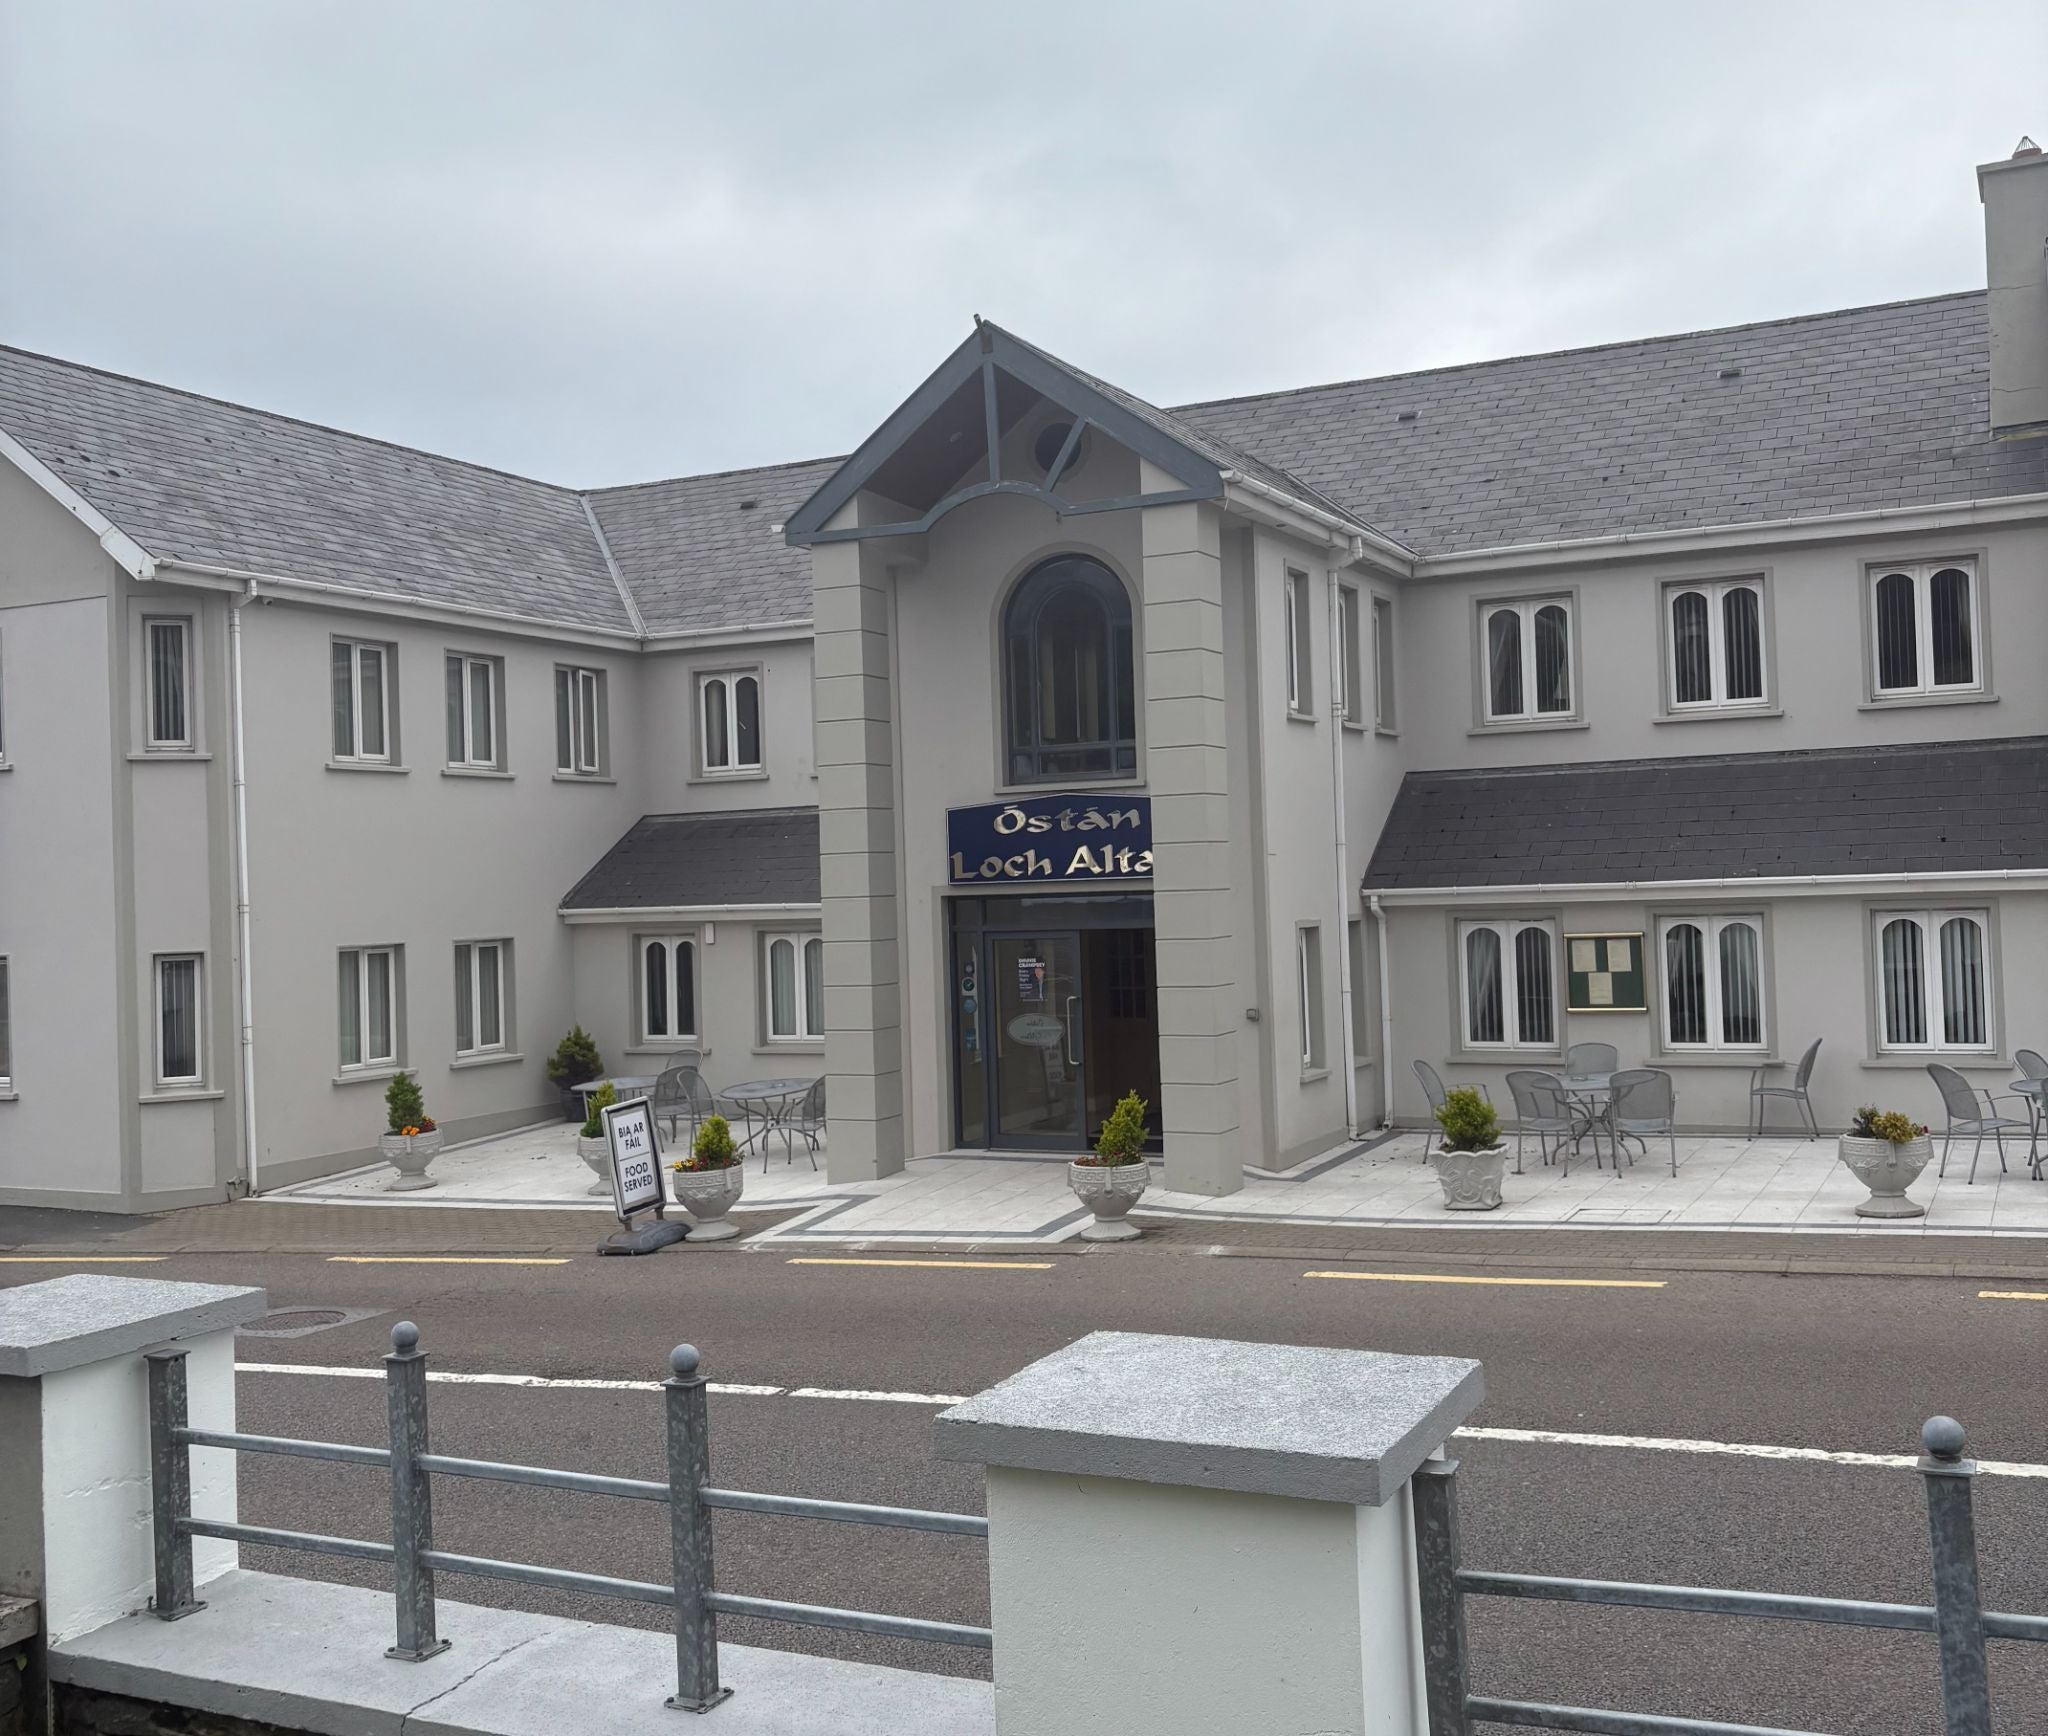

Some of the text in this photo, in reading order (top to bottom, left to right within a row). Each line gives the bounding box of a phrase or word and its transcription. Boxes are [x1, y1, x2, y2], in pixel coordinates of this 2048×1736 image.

[950, 849, 1053, 879] Loch
[618, 1121, 644, 1138] BIA AR
[625, 1162, 648, 1178] FOOD
[624, 1174, 653, 1192] SERVED
